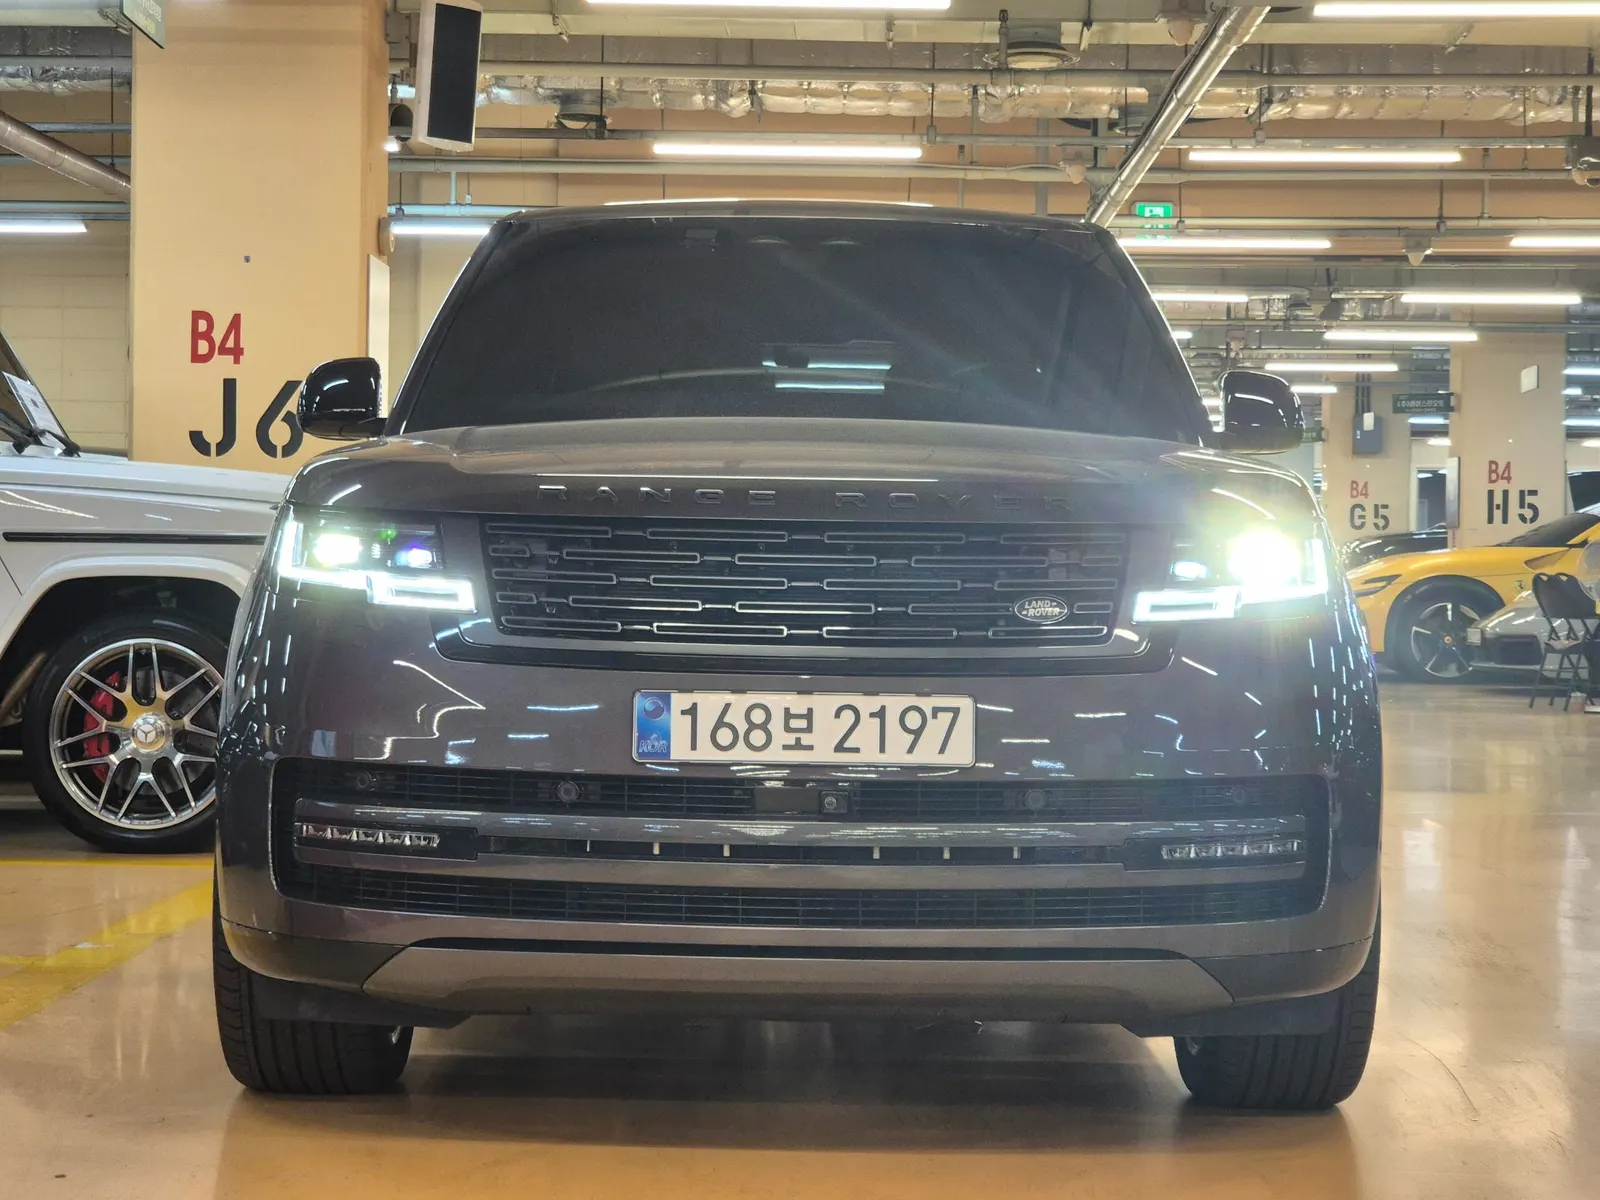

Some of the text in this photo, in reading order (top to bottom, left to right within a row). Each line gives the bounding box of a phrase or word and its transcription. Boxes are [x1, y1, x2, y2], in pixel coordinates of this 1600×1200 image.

[190, 310, 244, 364] B4
[1487, 459, 1513, 484] B4
[537, 485, 1071, 511] RANGE ROVER
[1350, 479, 1370, 500] B4
[1024, 599, 1051, 609] LAND
[1027, 607, 1060, 617] ROVER
[680, 702, 961, 755] 168보 2197
[638, 739, 668, 753] KOR
